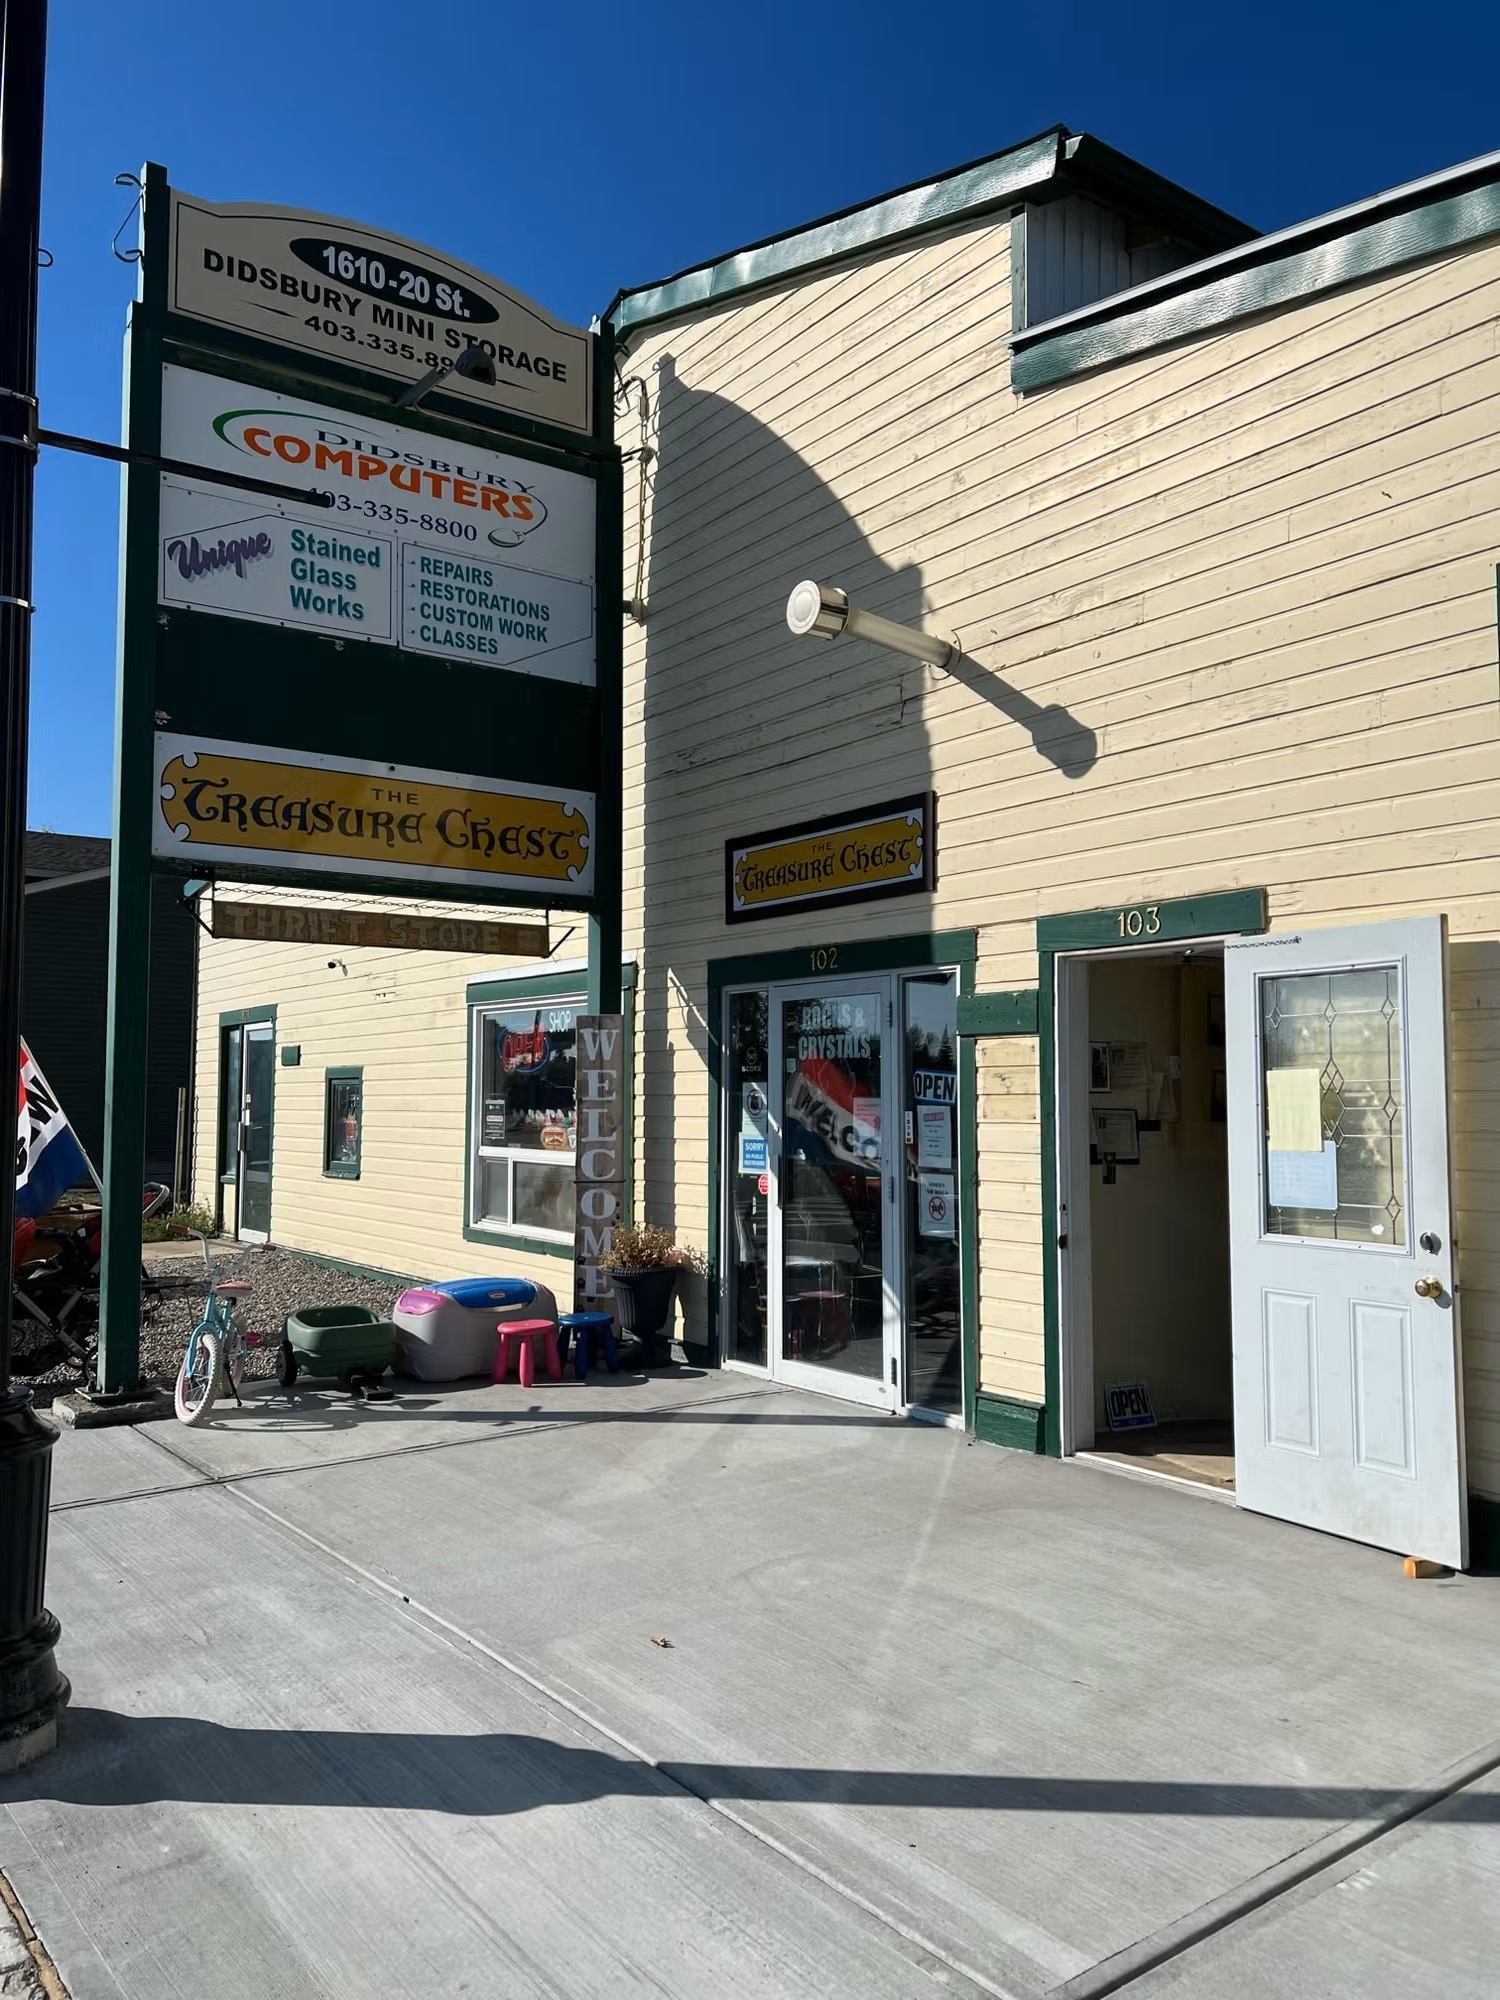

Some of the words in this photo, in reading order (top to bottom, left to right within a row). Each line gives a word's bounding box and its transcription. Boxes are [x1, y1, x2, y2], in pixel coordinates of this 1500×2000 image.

[203, 248, 362, 317] DIDSBURY
[371, 303, 435, 341] MINI
[444, 327, 567, 383] STORAGE
[435, 283, 470, 318] St.
[304, 315, 456, 369] 403.335.89
[243, 427, 534, 521] COMPUTERS
[315, 429, 536, 492] DIDSBURY
[307, 487, 478, 541] 03-335-8800
[167, 532, 273, 579] Unique
[290, 528, 380, 567] Stained
[290, 557, 357, 591] Glass
[420, 555, 494, 588] REPAIRS
[289, 584, 365, 620] Works
[420, 579, 550, 622] RESTORATIONS
[420, 602, 494, 632] CUSTOM
[498, 617, 549, 643] WORK
[420, 625, 499, 655] CLASSES
[370, 787, 420, 805] THE
[810, 841, 833, 854] THE
[224, 904, 369, 945] THRIFT
[387, 917, 502, 951] STORE
[1117, 906, 1161, 938] 103
[809, 947, 838, 972] 102
[549, 1010, 572, 1033] SHOP
[801, 1003, 852, 1030] ROCKS
[854, 1007, 866, 1028] &
[798, 1032, 872, 1061] CRYSTALS
[913, 1071, 957, 1104] OPEN
[578, 1028, 620, 1299] WELCOME
[744, 1142, 765, 1152] SORRY
[1109, 1387, 1151, 1418] OPEN
